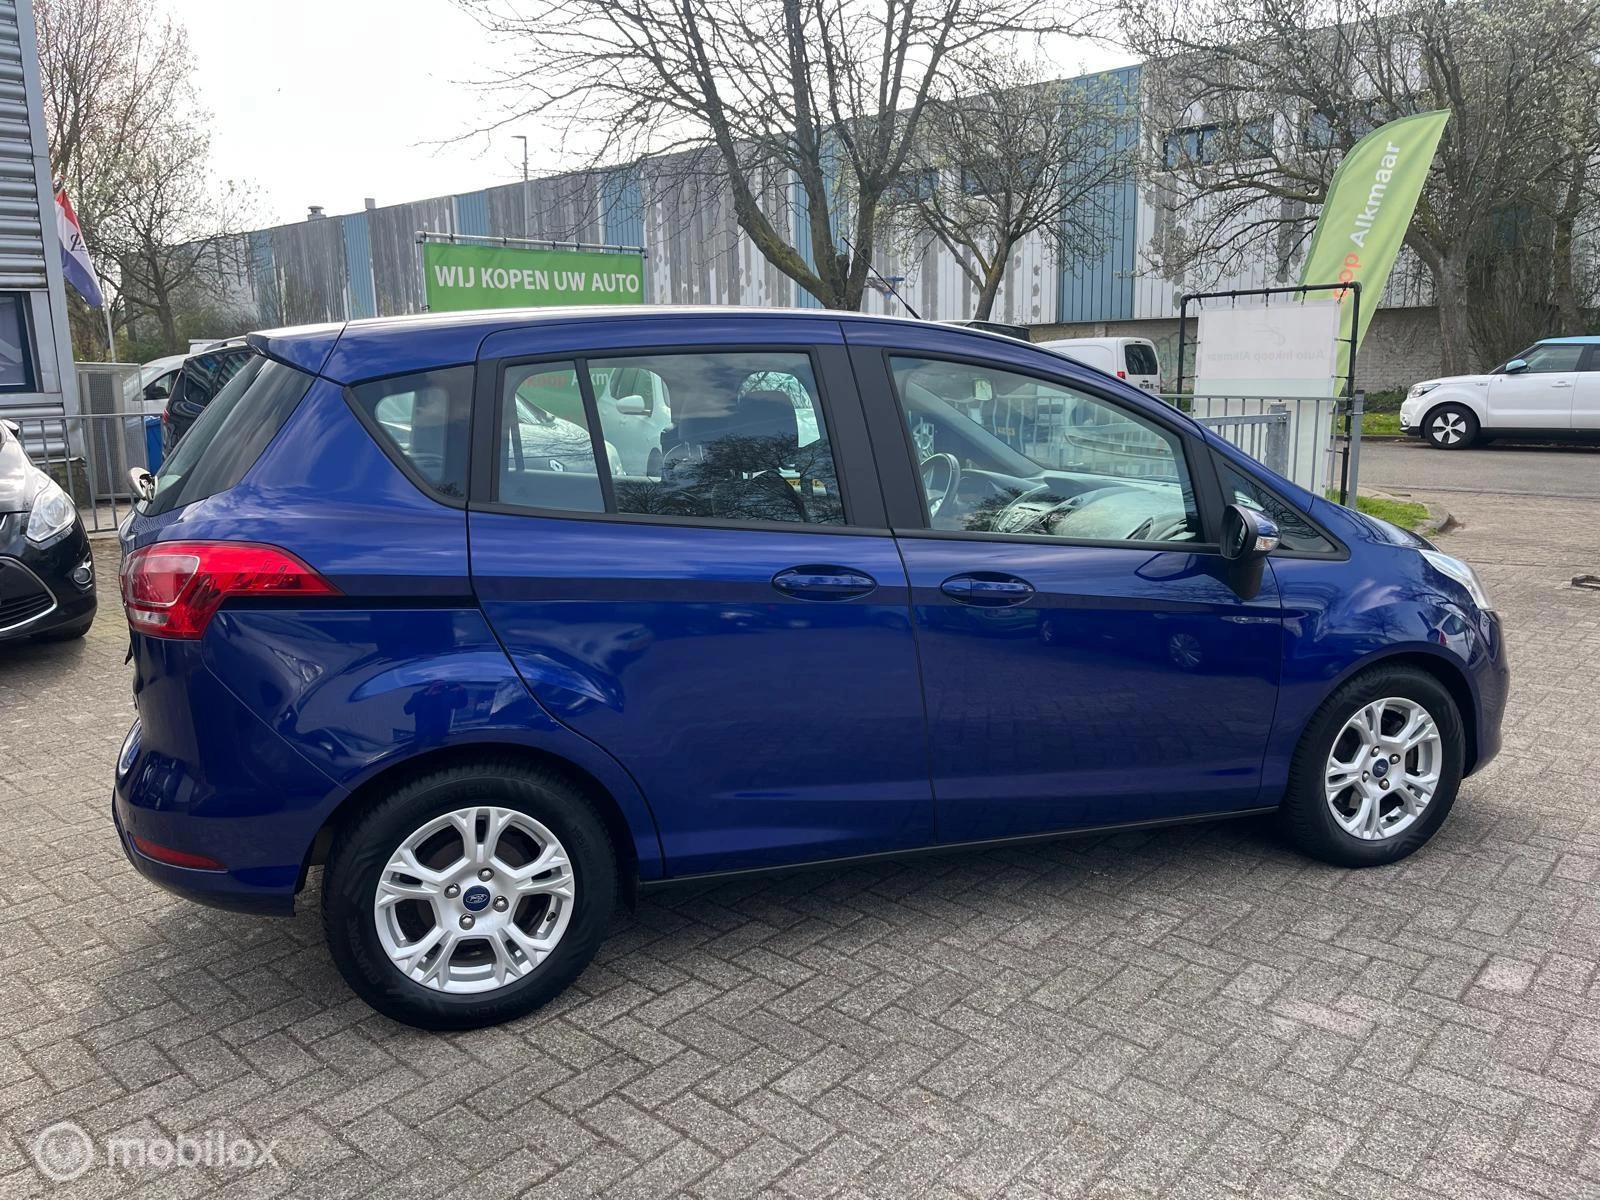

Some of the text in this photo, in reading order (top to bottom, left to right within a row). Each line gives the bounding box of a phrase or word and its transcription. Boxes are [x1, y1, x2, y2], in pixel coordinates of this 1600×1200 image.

[1350, 141, 1400, 248] Alkmaar
[434, 265, 639, 293] WIJ KOPEN UW AUTO
